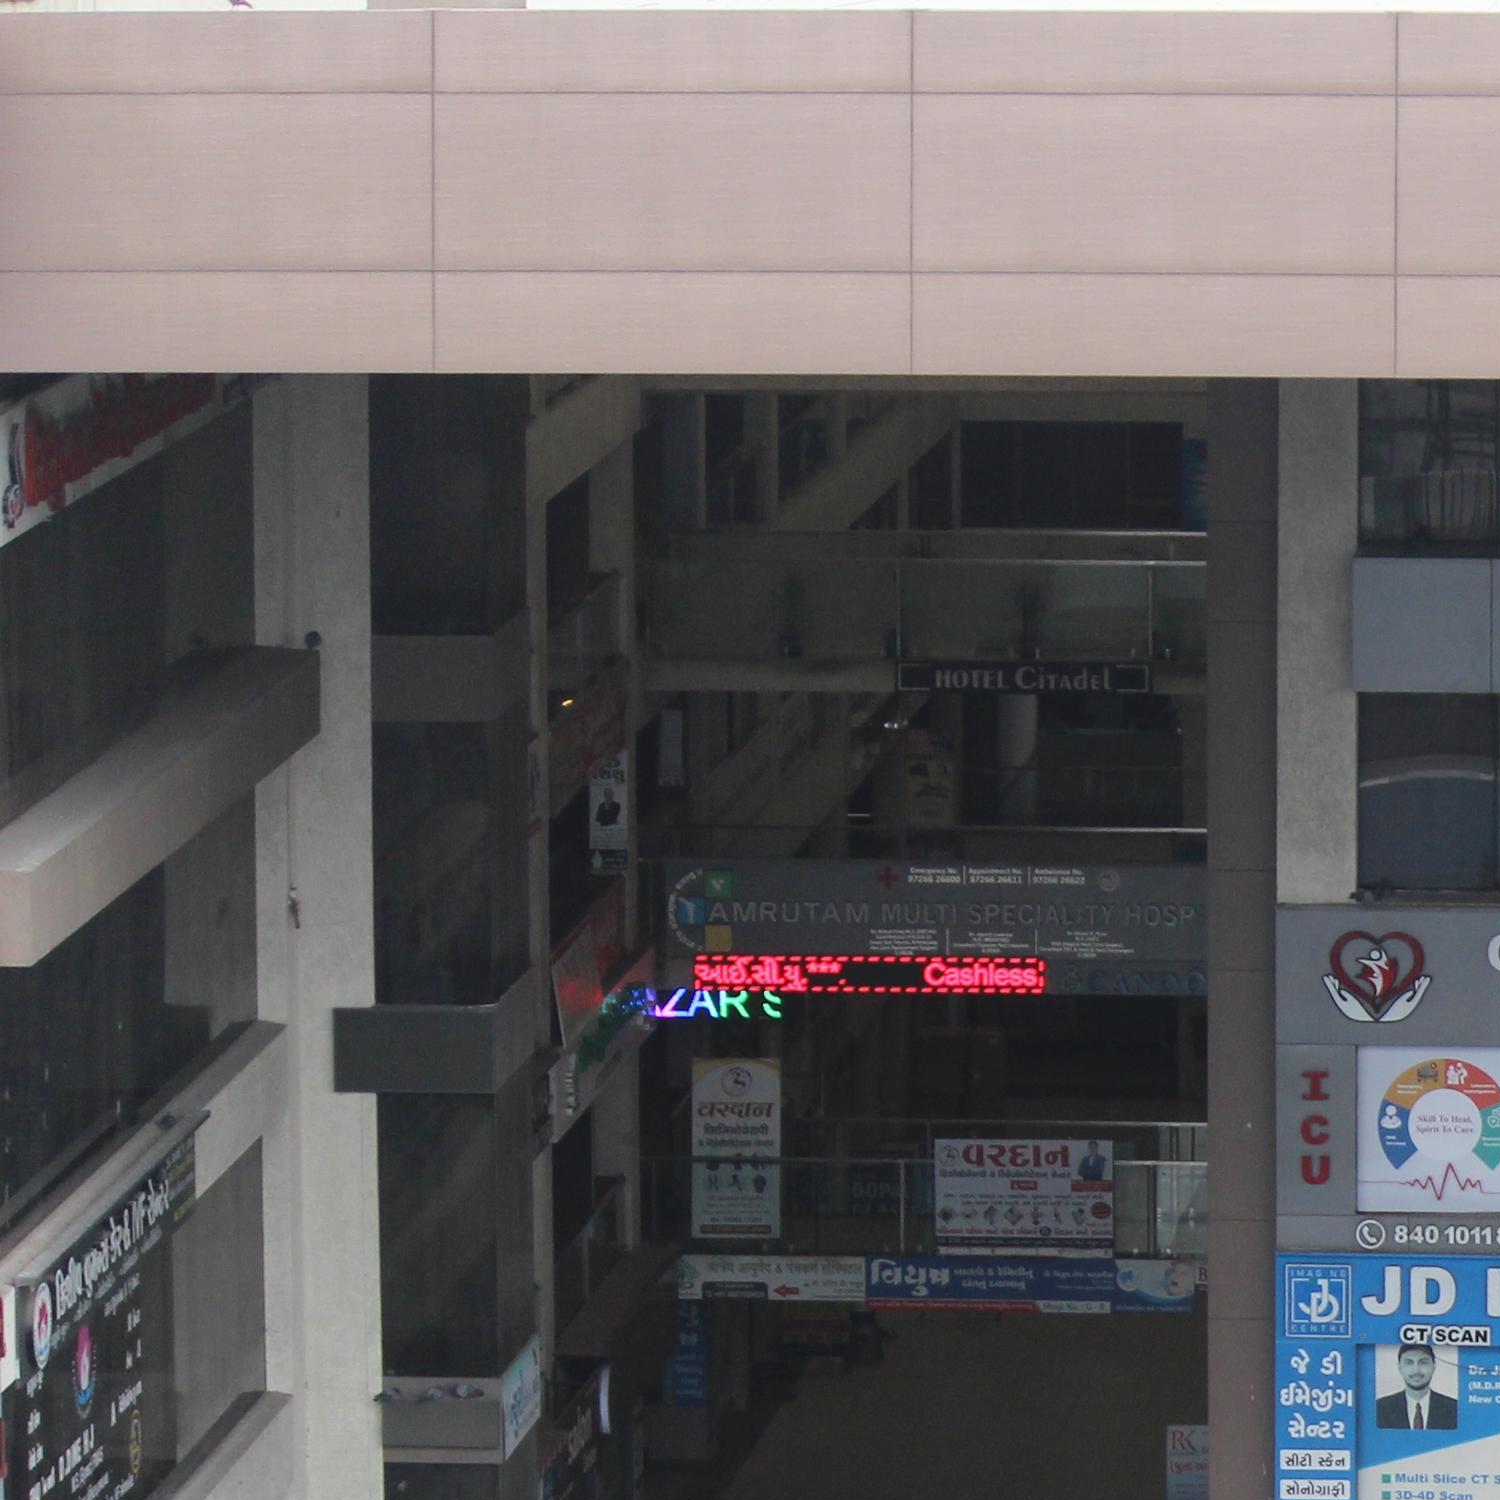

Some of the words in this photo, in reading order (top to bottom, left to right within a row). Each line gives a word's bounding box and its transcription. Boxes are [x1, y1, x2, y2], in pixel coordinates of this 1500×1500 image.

[934, 668, 1010, 690] HOTEL
[708, 901, 870, 925] AMRUTAM
[881, 902, 957, 925] MULTI
[967, 903, 1116, 927] SPECIALITY
[923, 960, 1039, 988] Cashless
[961, 1143, 1071, 1168] વરદાન
[1360, 1265, 1457, 1320] JD
[1401, 1327, 1430, 1343] CT
[1434, 1328, 1489, 1344] SCAN
[1290, 1348, 1310, 1376] જે
[1319, 1350, 1342, 1375] ડી
[1287, 1413, 1346, 1439] સેન્ટર
[1394, 1473, 1429, 1485] Multi
[1432, 1473, 1467, 1485] Slice
[1471, 1474, 1490, 1485] CT
